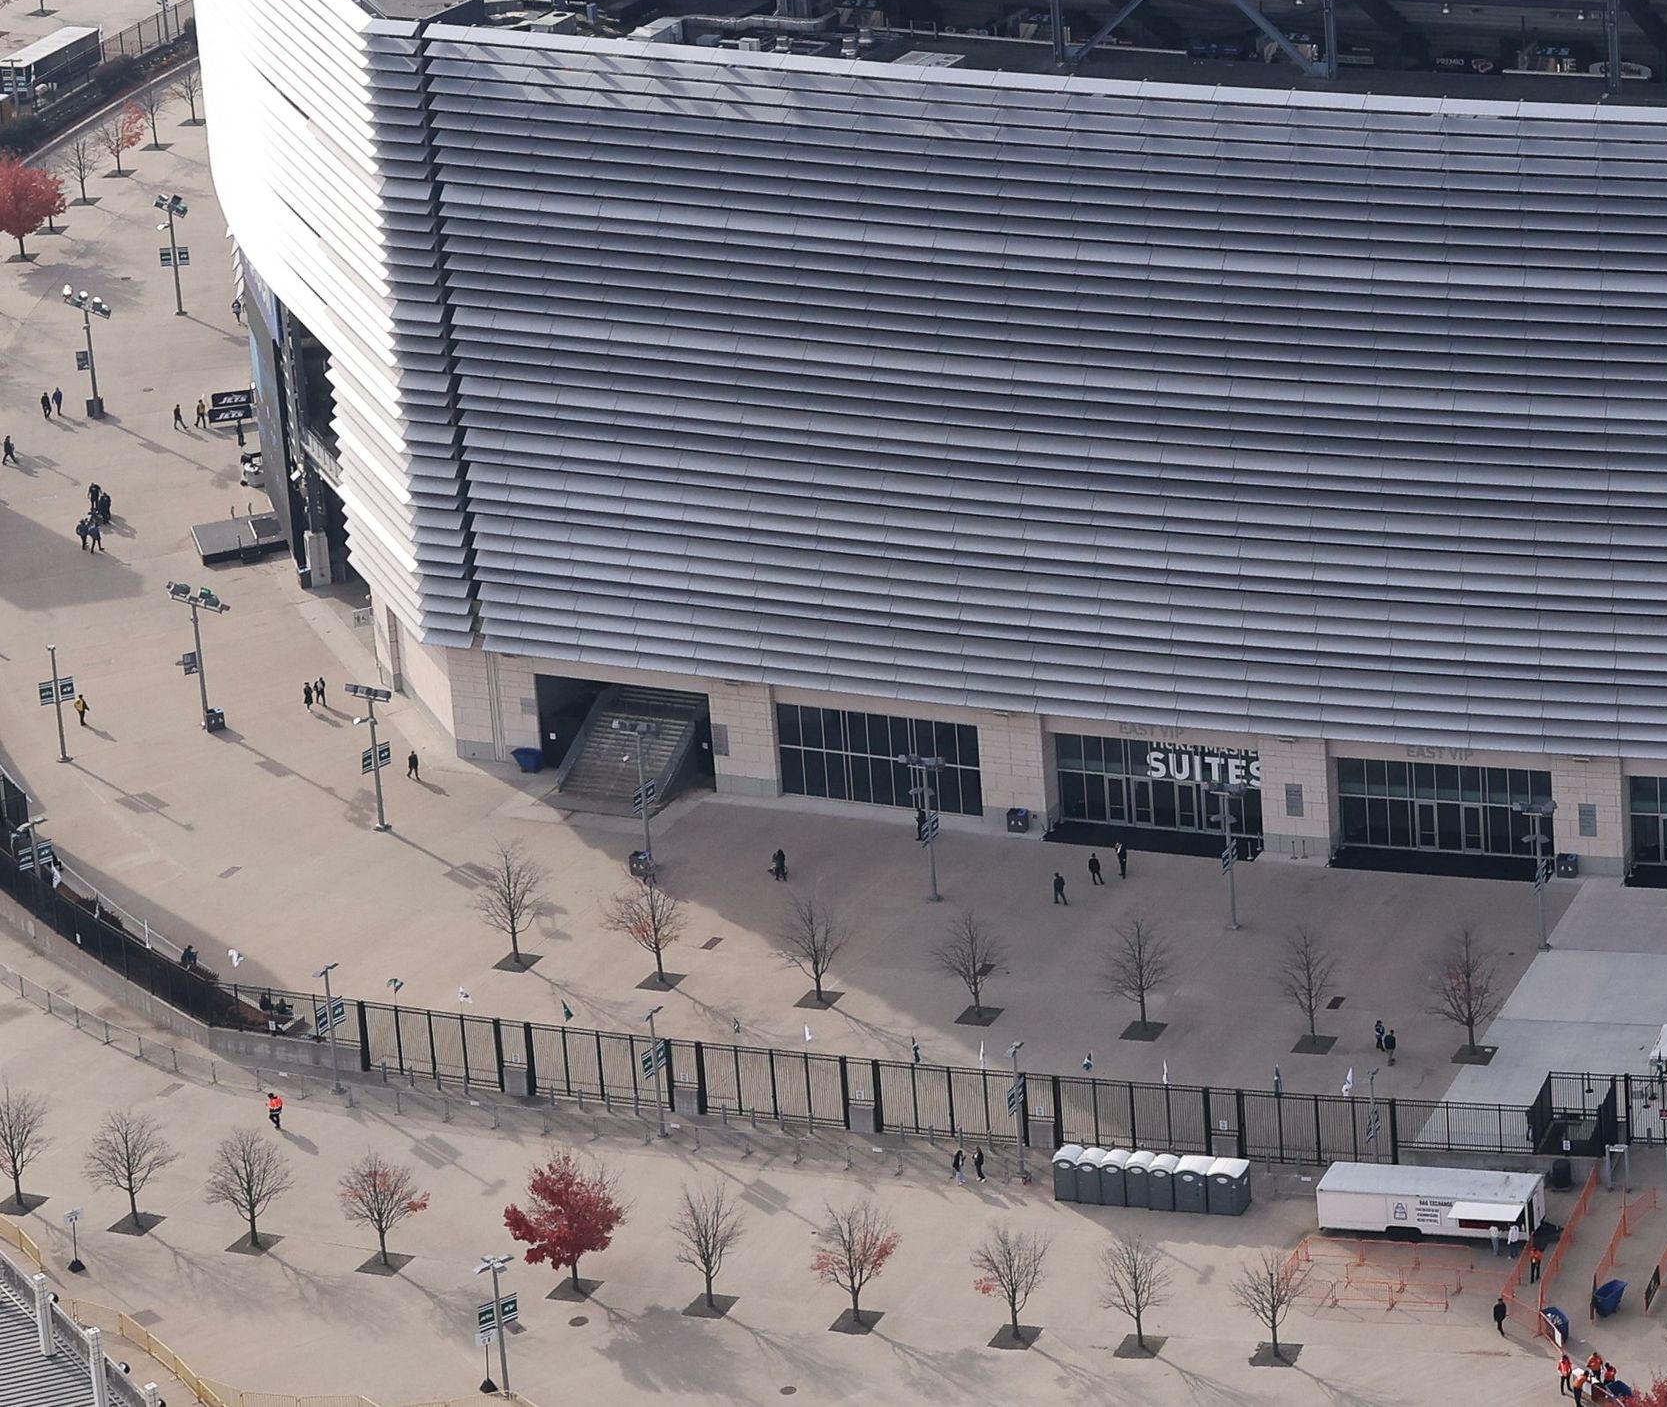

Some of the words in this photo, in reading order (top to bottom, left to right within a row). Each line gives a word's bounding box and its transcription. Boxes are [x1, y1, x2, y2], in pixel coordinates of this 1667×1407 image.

[1119, 722, 1158, 738] EAST
[1160, 725, 1185, 740] VIP
[1406, 747, 1444, 759] EAST
[1449, 748, 1474, 761] VIP
